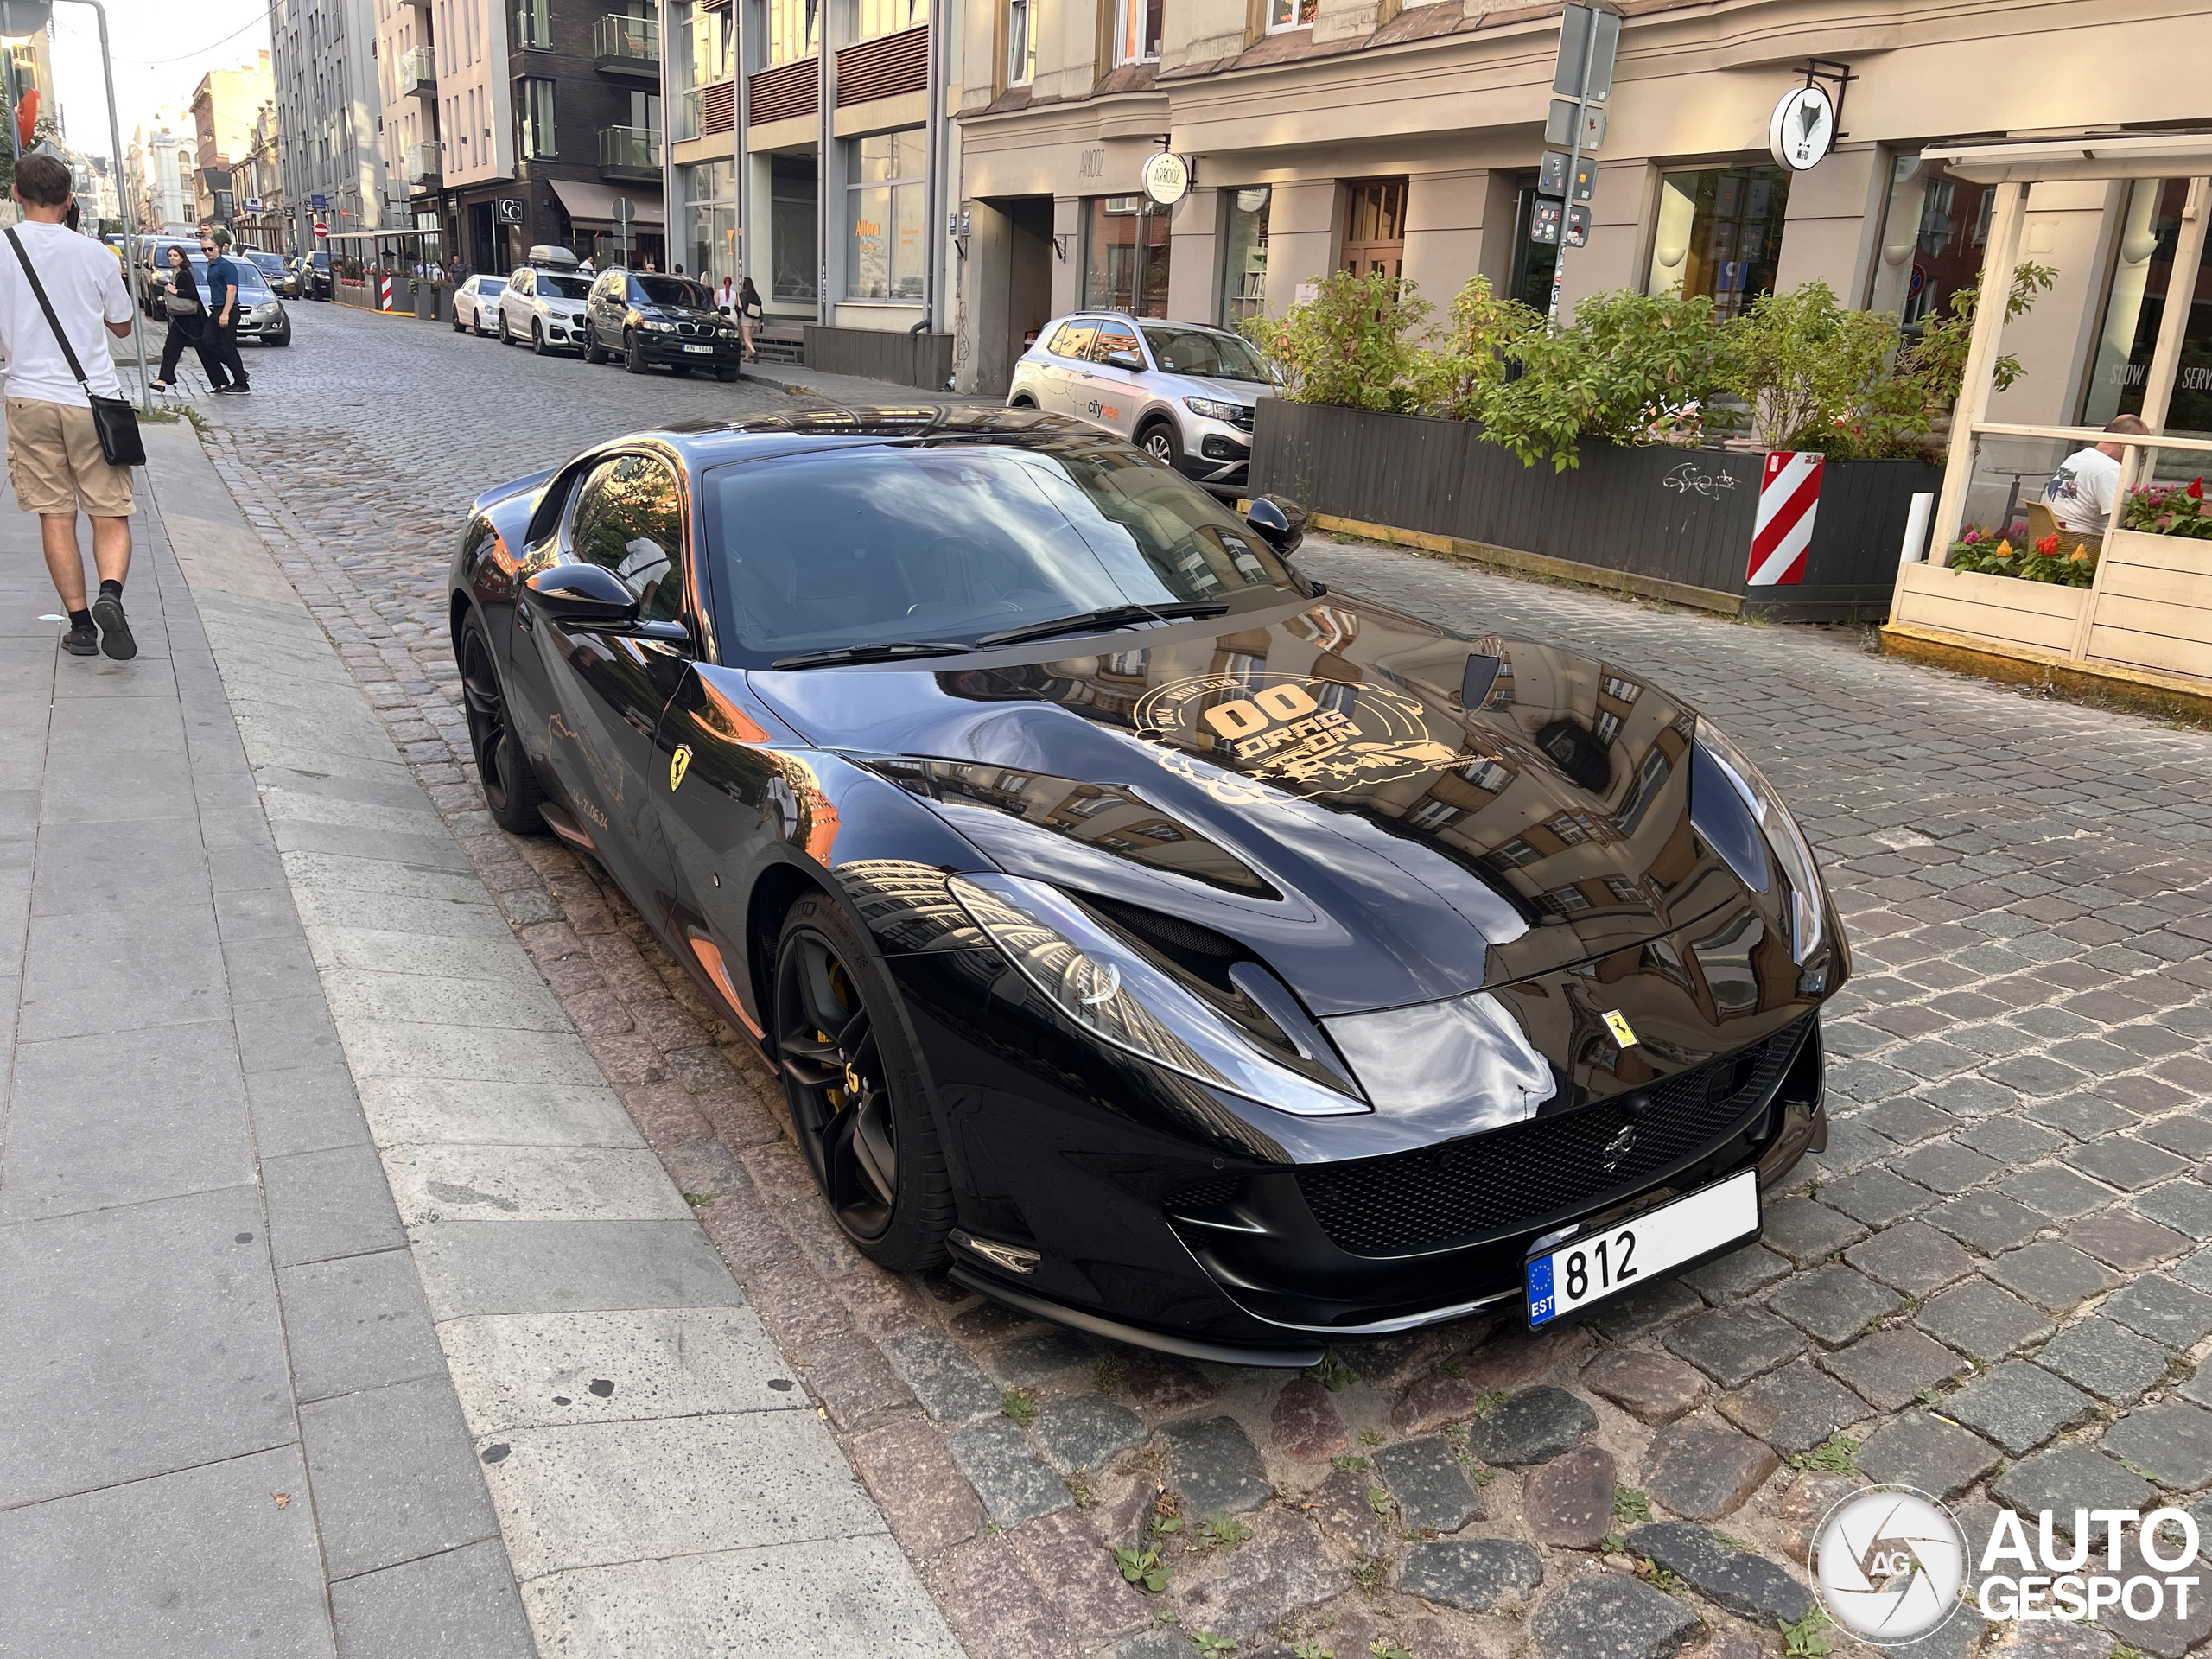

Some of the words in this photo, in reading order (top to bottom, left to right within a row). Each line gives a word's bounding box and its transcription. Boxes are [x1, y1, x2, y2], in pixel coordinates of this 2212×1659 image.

[1078, 149, 1105, 178] ARBOOZ
[1154, 168, 1181, 185] ARBOOZ
[855, 219, 880, 237] Allora
[2110, 364, 2145, 385] SLOW
[1088, 399, 1120, 421] citybee
[1155, 708, 1176, 725] 2024
[1166, 685, 1205, 702] DRIVE
[1202, 678, 1241, 690] CLUB
[1567, 1230, 1637, 1300] 812
[1531, 1295, 1554, 1317] EST
